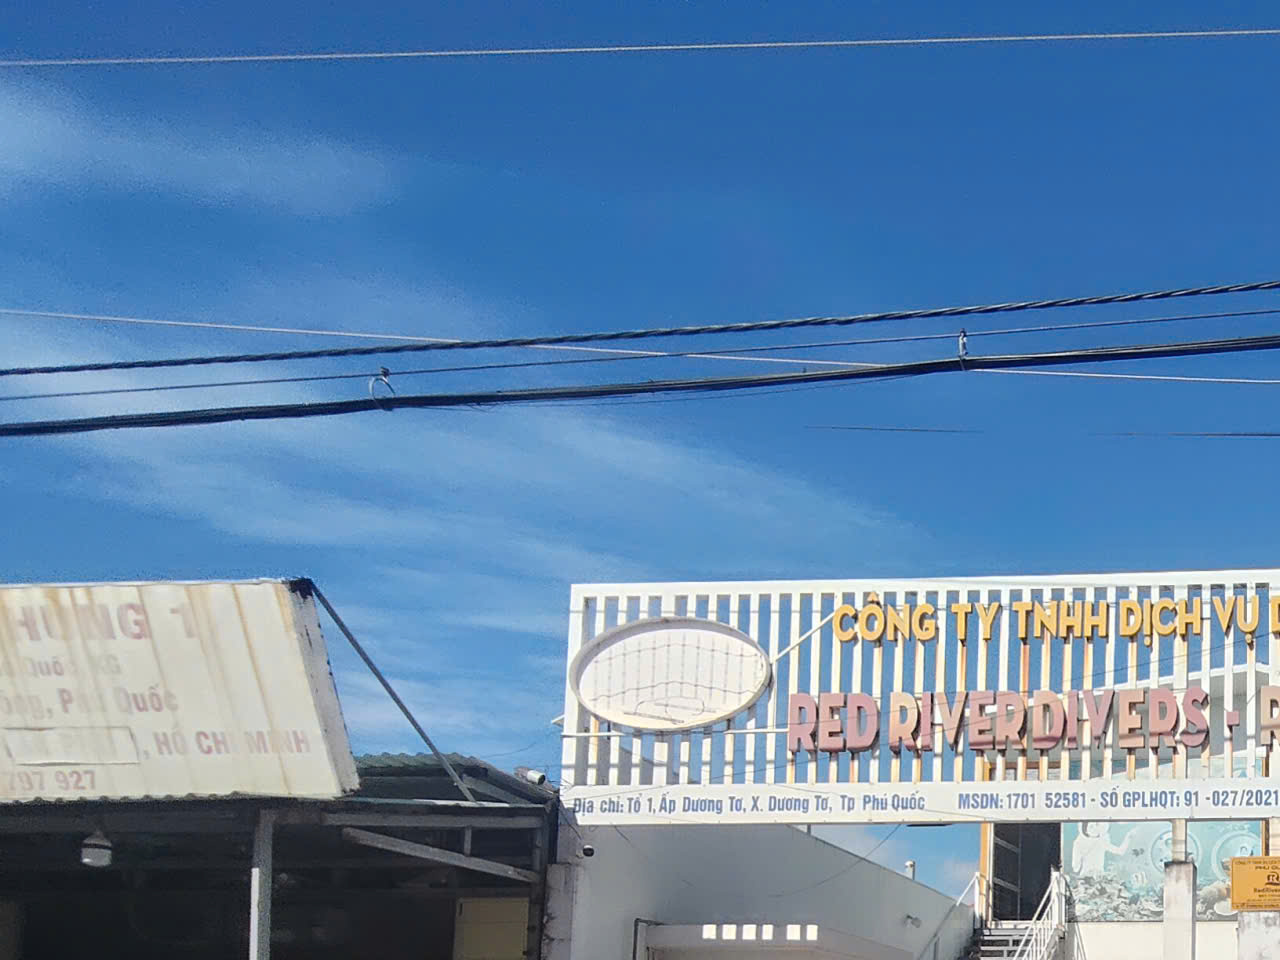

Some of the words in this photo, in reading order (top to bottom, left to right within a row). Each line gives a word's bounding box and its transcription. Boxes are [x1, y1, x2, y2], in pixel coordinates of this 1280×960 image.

[832, 592, 936, 641] CÔNG
[951, 602, 999, 641] TY
[1012, 600, 1108, 640] TNHH
[1118, 597, 1202, 646] DỊCH
[1212, 594, 1260, 644] VỤ
[788, 692, 880, 752] RED
[888, 689, 1027, 752] RIVER
[1032, 683, 1210, 751] DIVERS
[682, 796, 723, 815] Dương
[751, 795, 764, 812] X.
[768, 795, 809, 814] Dương
[840, 794, 856, 813] Tp
[862, 792, 888, 812] Phú
[891, 790, 926, 811] Quốc
[957, 792, 1004, 811] MSDN:
[1006, 792, 1036, 810] 1701
[1045, 791, 1087, 810] 52581
